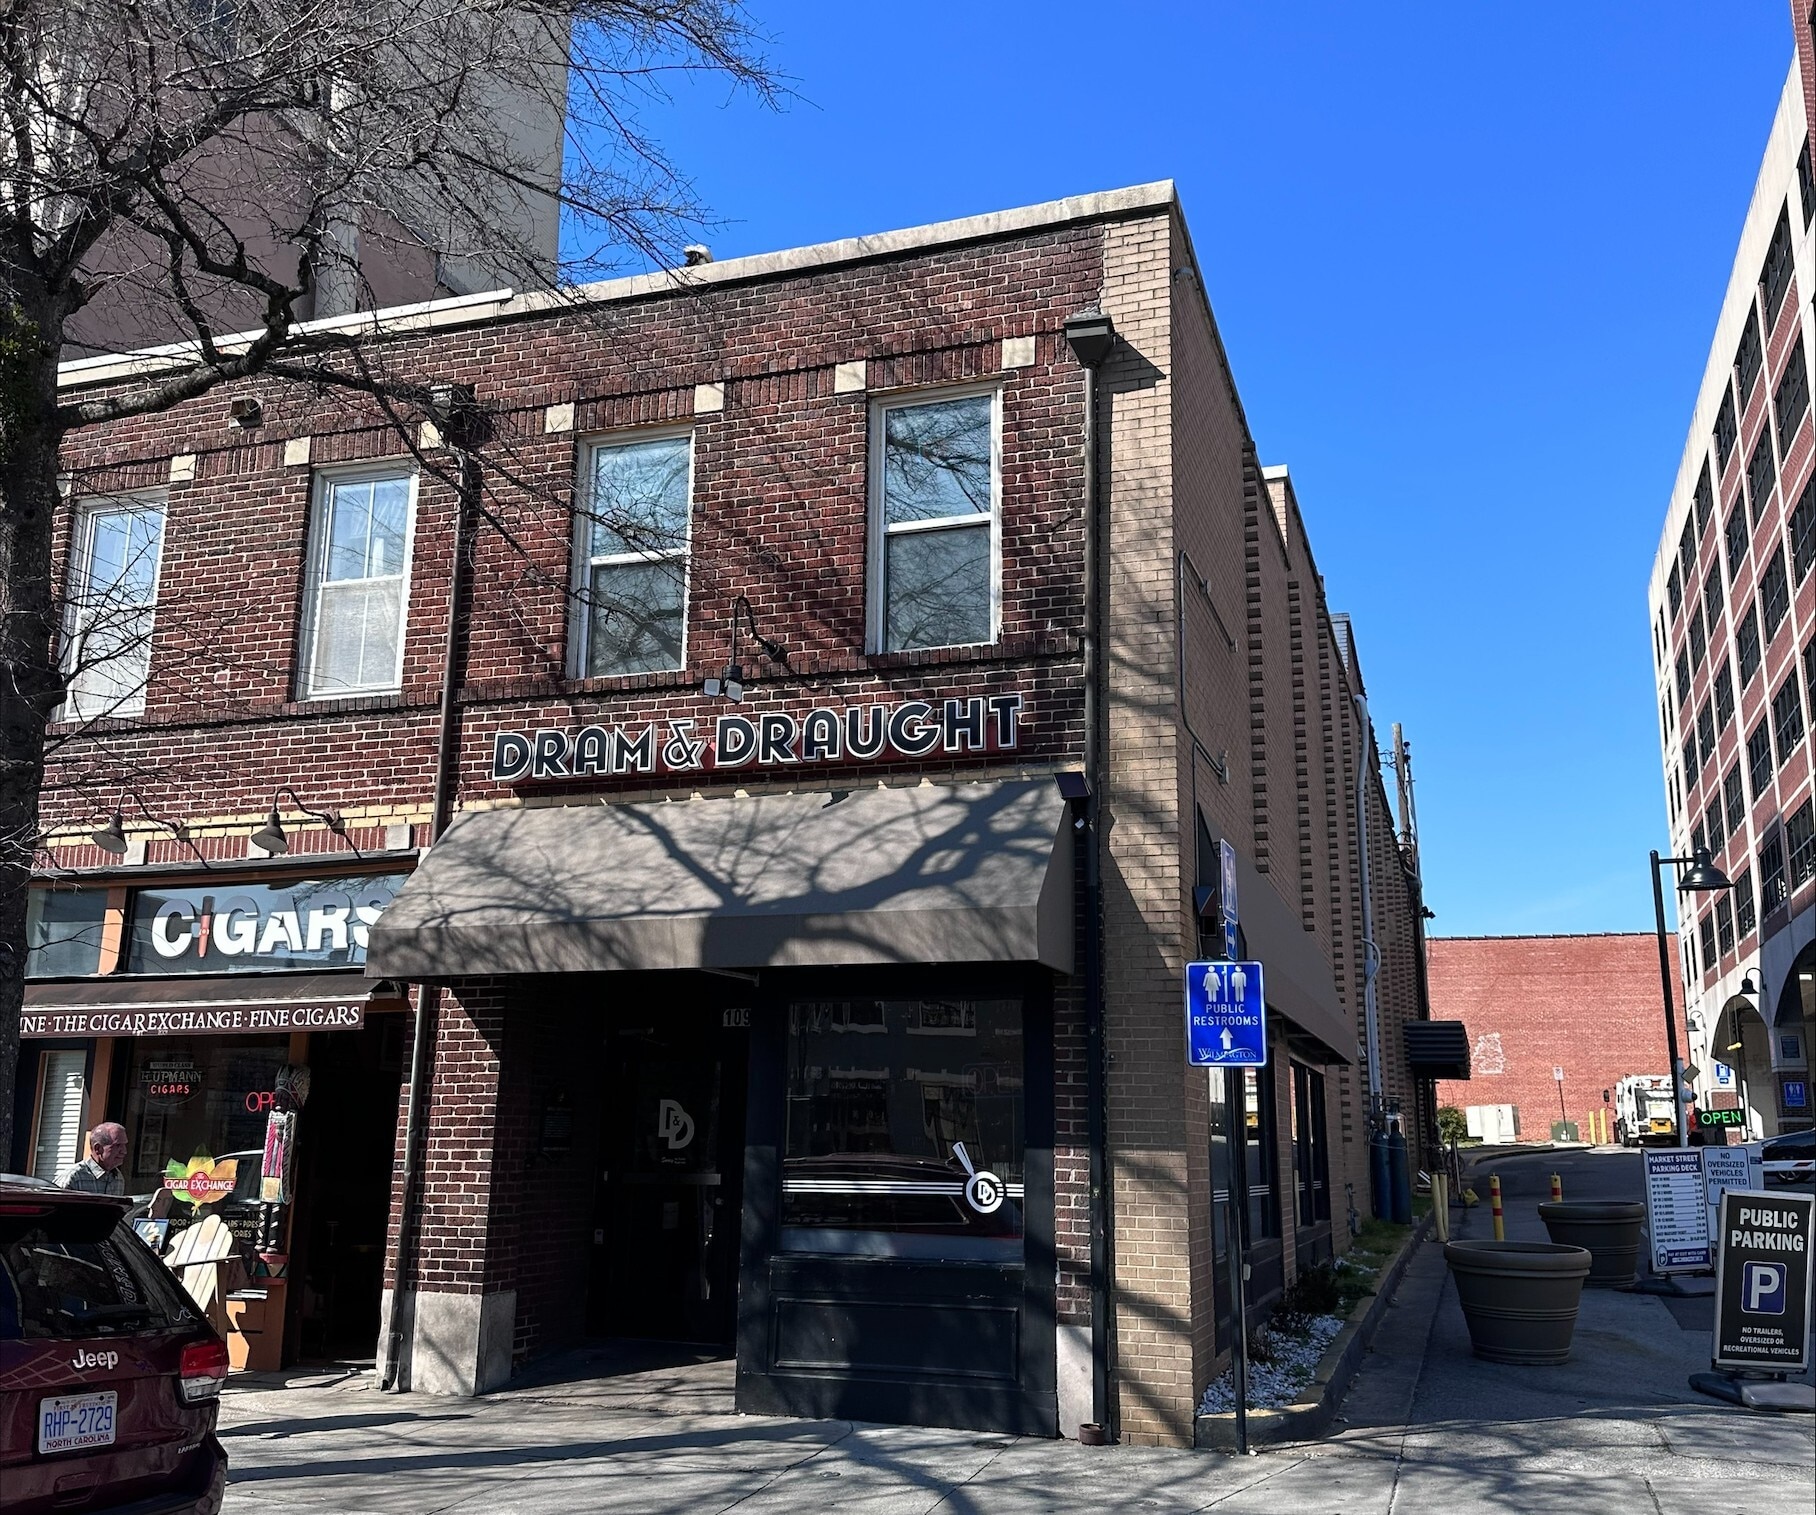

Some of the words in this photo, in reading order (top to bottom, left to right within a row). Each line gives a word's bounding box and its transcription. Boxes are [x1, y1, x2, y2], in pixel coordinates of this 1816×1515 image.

[491, 722, 657, 782] DRAM
[662, 719, 708, 770] &
[714, 693, 1023, 767] DRAUGHT
[1206, 1004, 1245, 1014] PUBLIC
[53, 1014, 88, 1032] THE
[90, 1012, 148, 1032] CIGAR
[147, 1010, 242, 1031] EXCHANGE
[249, 1009, 290, 1027] FINE
[292, 1006, 360, 1026] CIGARS
[725, 1008, 750, 1025] 109
[1193, 1015, 1259, 1026] RESTROOMS
[150, 1084, 190, 1095] CIGARS
[246, 1091, 276, 1112] OP
[1701, 1110, 1742, 1125] OPEN
[1649, 1155, 1674, 1163] MARKET
[1674, 1154, 1699, 1162] STREET
[1707, 1160, 1745, 1168] OVERSIZED
[1651, 1165, 1680, 1173] PARKING
[1681, 1164, 1698, 1172] DECK
[1710, 1169, 1744, 1177] VEHICLES
[164, 1180, 189, 1190] CIGAR
[190, 1179, 234, 1191] EXCHANGE
[1739, 1207, 1798, 1229] PUBLIC
[1731, 1229, 1804, 1252] PARKING
[1750, 1265, 1780, 1309] P
[1742, 1326, 1752, 1334] NO
[1753, 1327, 1784, 1337] TRAILERS,
[1740, 1336, 1775, 1344] OVERSIZED
[1723, 1344, 1769, 1354] RECREATIONAL
[1770, 1347, 1800, 1356] VEHICLES
[72, 1348, 119, 1370] Jeep
[44, 1405, 113, 1439] RHP-2729
[46, 1438, 72, 1449] NORTH
[74, 1433, 110, 1445] CAROLINA
